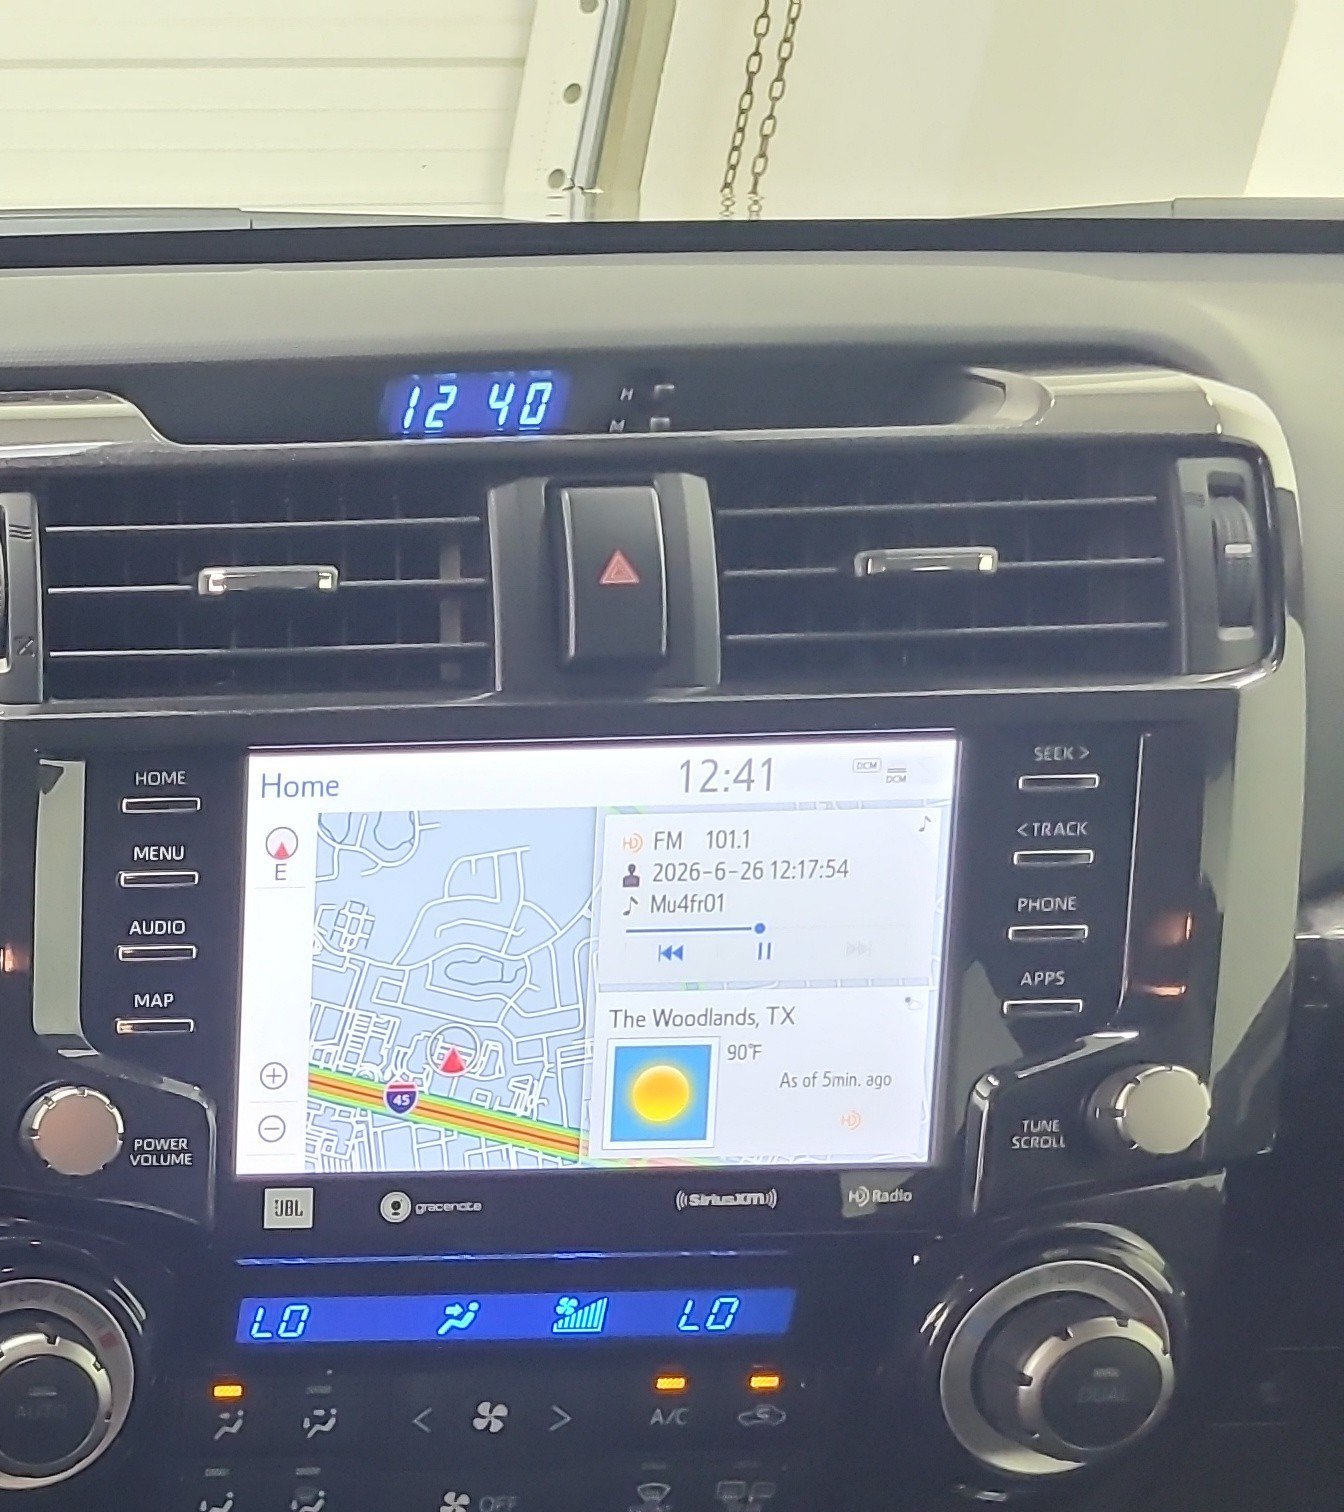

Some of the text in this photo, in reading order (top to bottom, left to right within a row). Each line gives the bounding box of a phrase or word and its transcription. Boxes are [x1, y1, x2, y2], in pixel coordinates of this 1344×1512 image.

[403, 381, 553, 429] 12 40
[1034, 745, 1074, 762] SEEK
[135, 770, 187, 787] HOME
[679, 757, 773, 793] 12:41
[261, 772, 340, 798] Home
[1032, 820, 1089, 837] TRACK
[653, 830, 683, 850] FM
[706, 829, 750, 850] 101.1
[133, 844, 185, 862] MENU
[275, 863, 287, 881] E
[652, 859, 850, 882] 2026-6-26 12:17:54
[1017, 896, 1078, 912] PHONE
[129, 919, 187, 936] AUDIO
[1020, 971, 1066, 987] APPS
[134, 992, 175, 1008] MAP
[609, 1006, 796, 1029] The Woodlands, TX
[779, 1071, 892, 1090] As of 5min. ago
[392, 1094, 411, 1107] 45
[1022, 1118, 1061, 1134] TUNE
[134, 1138, 189, 1152] POWER
[1011, 1135, 1066, 1150] SCROLL
[130, 1152, 193, 1167] VOLUME
[872, 1189, 913, 1204] Radio
[274, 1199, 304, 1218] JBL
[415, 1201, 483, 1216] gracenote
[650, 1406, 690, 1426] A/C
